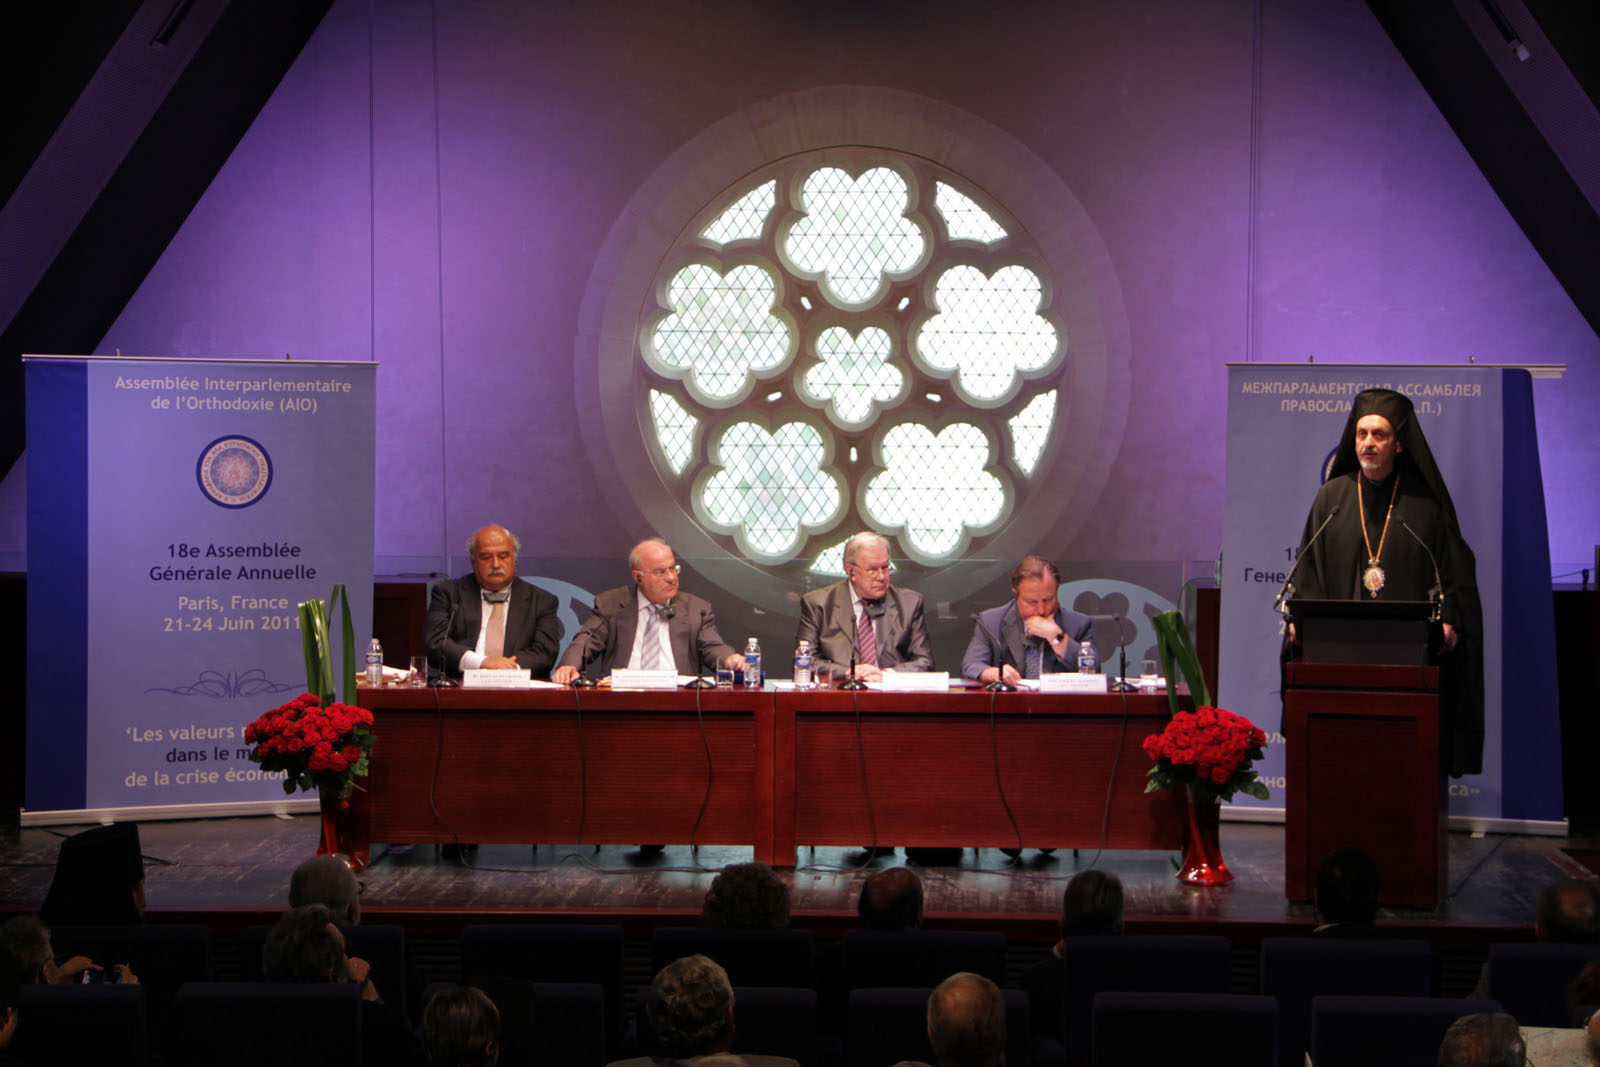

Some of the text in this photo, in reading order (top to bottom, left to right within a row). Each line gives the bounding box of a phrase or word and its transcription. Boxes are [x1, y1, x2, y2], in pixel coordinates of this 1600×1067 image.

[115, 376, 352, 394] Assemblée Interparlementaire
[1397, 383, 1481, 396] АССАМБЛЕЯ
[151, 396, 170, 409] de
[280, 398, 318, 414] (AIO)
[1281, 400, 1353, 412] ПРАВОСЛА
[168, 542, 301, 558] 18e Assemblée
[150, 565, 317, 581] Générale Annuelle
[1244, 568, 1287, 583] Гене
[178, 595, 289, 612] Paris, France
[164, 615, 301, 631] 21-24 Juin 2011
[169, 725, 235, 740] valeurs
[166, 748, 207, 762] dans
[214, 746, 230, 760] le
[124, 772, 147, 787] de
[154, 771, 169, 785] la
[176, 769, 219, 784] crise
